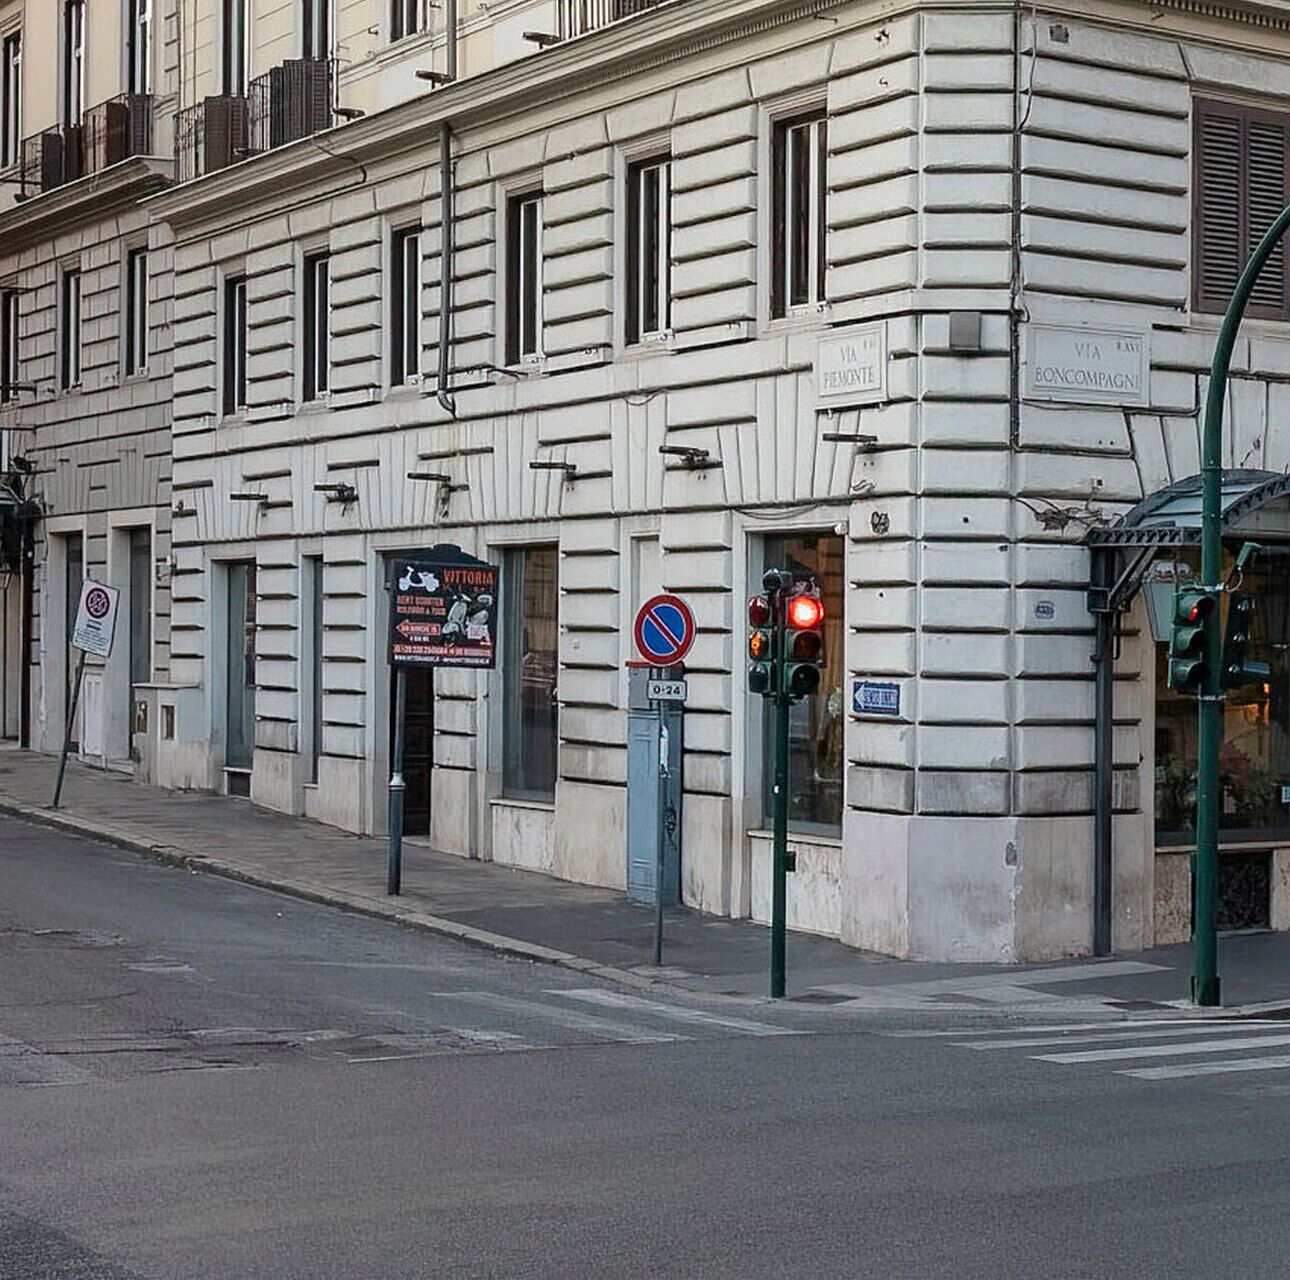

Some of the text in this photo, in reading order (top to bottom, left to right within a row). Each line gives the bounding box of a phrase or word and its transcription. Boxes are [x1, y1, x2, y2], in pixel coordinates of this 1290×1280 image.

[840, 345, 857, 362] VIA
[1074, 343, 1101, 361] VIA
[823, 366, 877, 389] PIEMONTE
[1035, 367, 1139, 389] BONCOMPAGNI
[443, 569, 493, 585] VITTORIA
